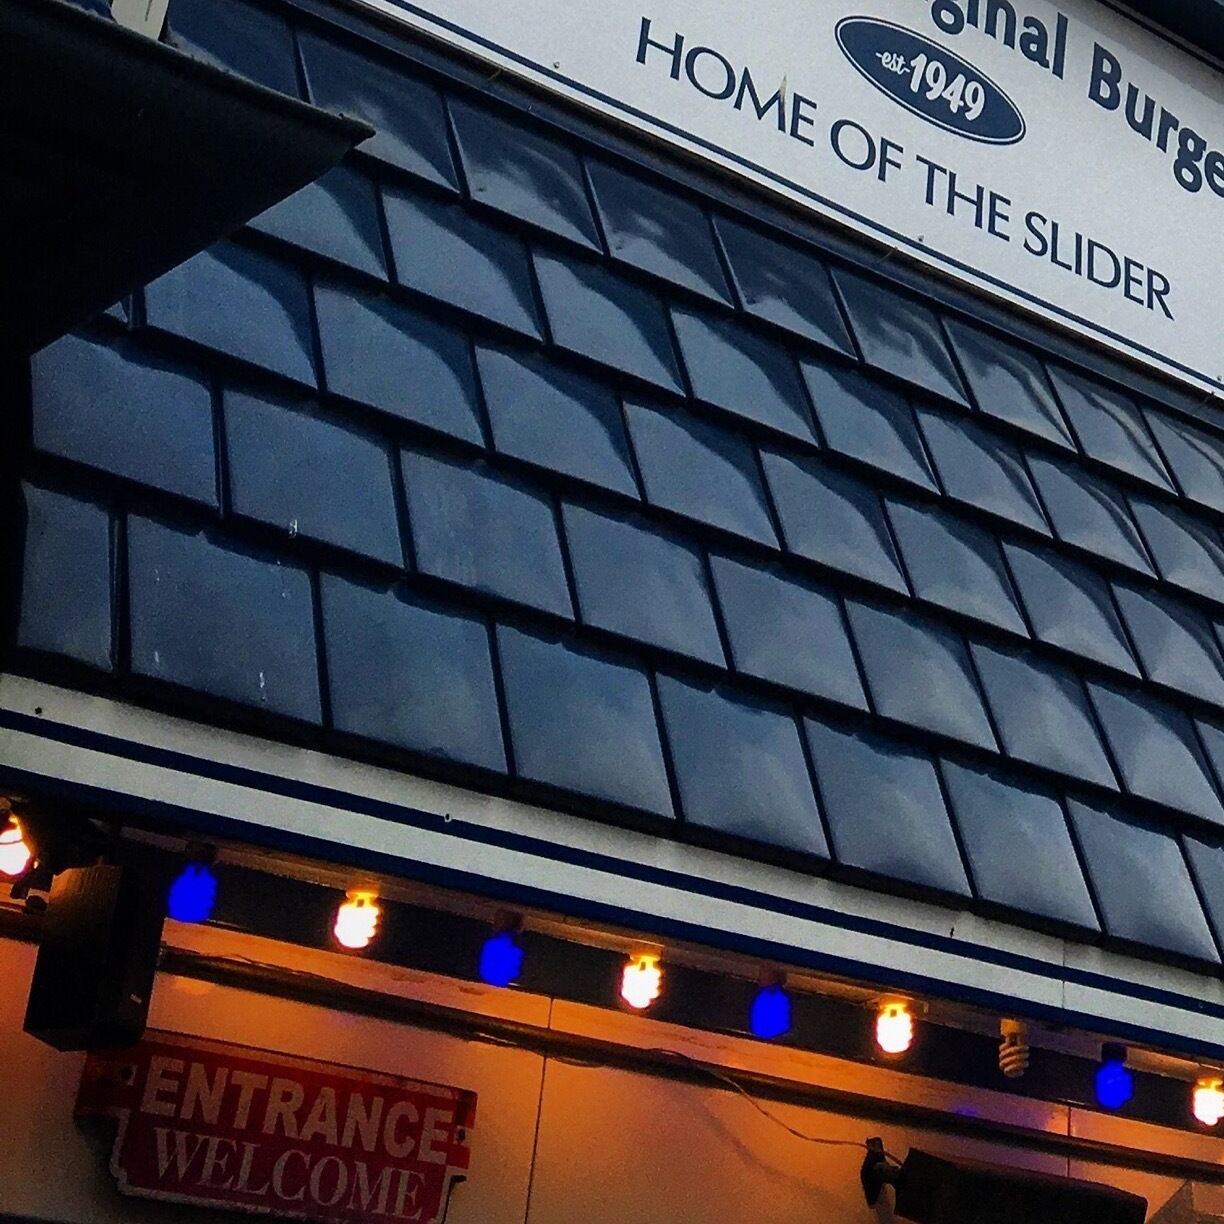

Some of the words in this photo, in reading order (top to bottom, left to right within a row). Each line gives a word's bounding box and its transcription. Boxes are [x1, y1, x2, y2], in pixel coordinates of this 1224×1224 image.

[910, 53, 986, 121] 1949
[636, 17, 817, 147] HOME
[830, 119, 904, 182] OF
[916, 153, 1011, 243] THE
[1023, 211, 1175, 321] SLIDER
[140, 1055, 454, 1164] ENTRANCE
[153, 1127, 426, 1221] WELCOME
